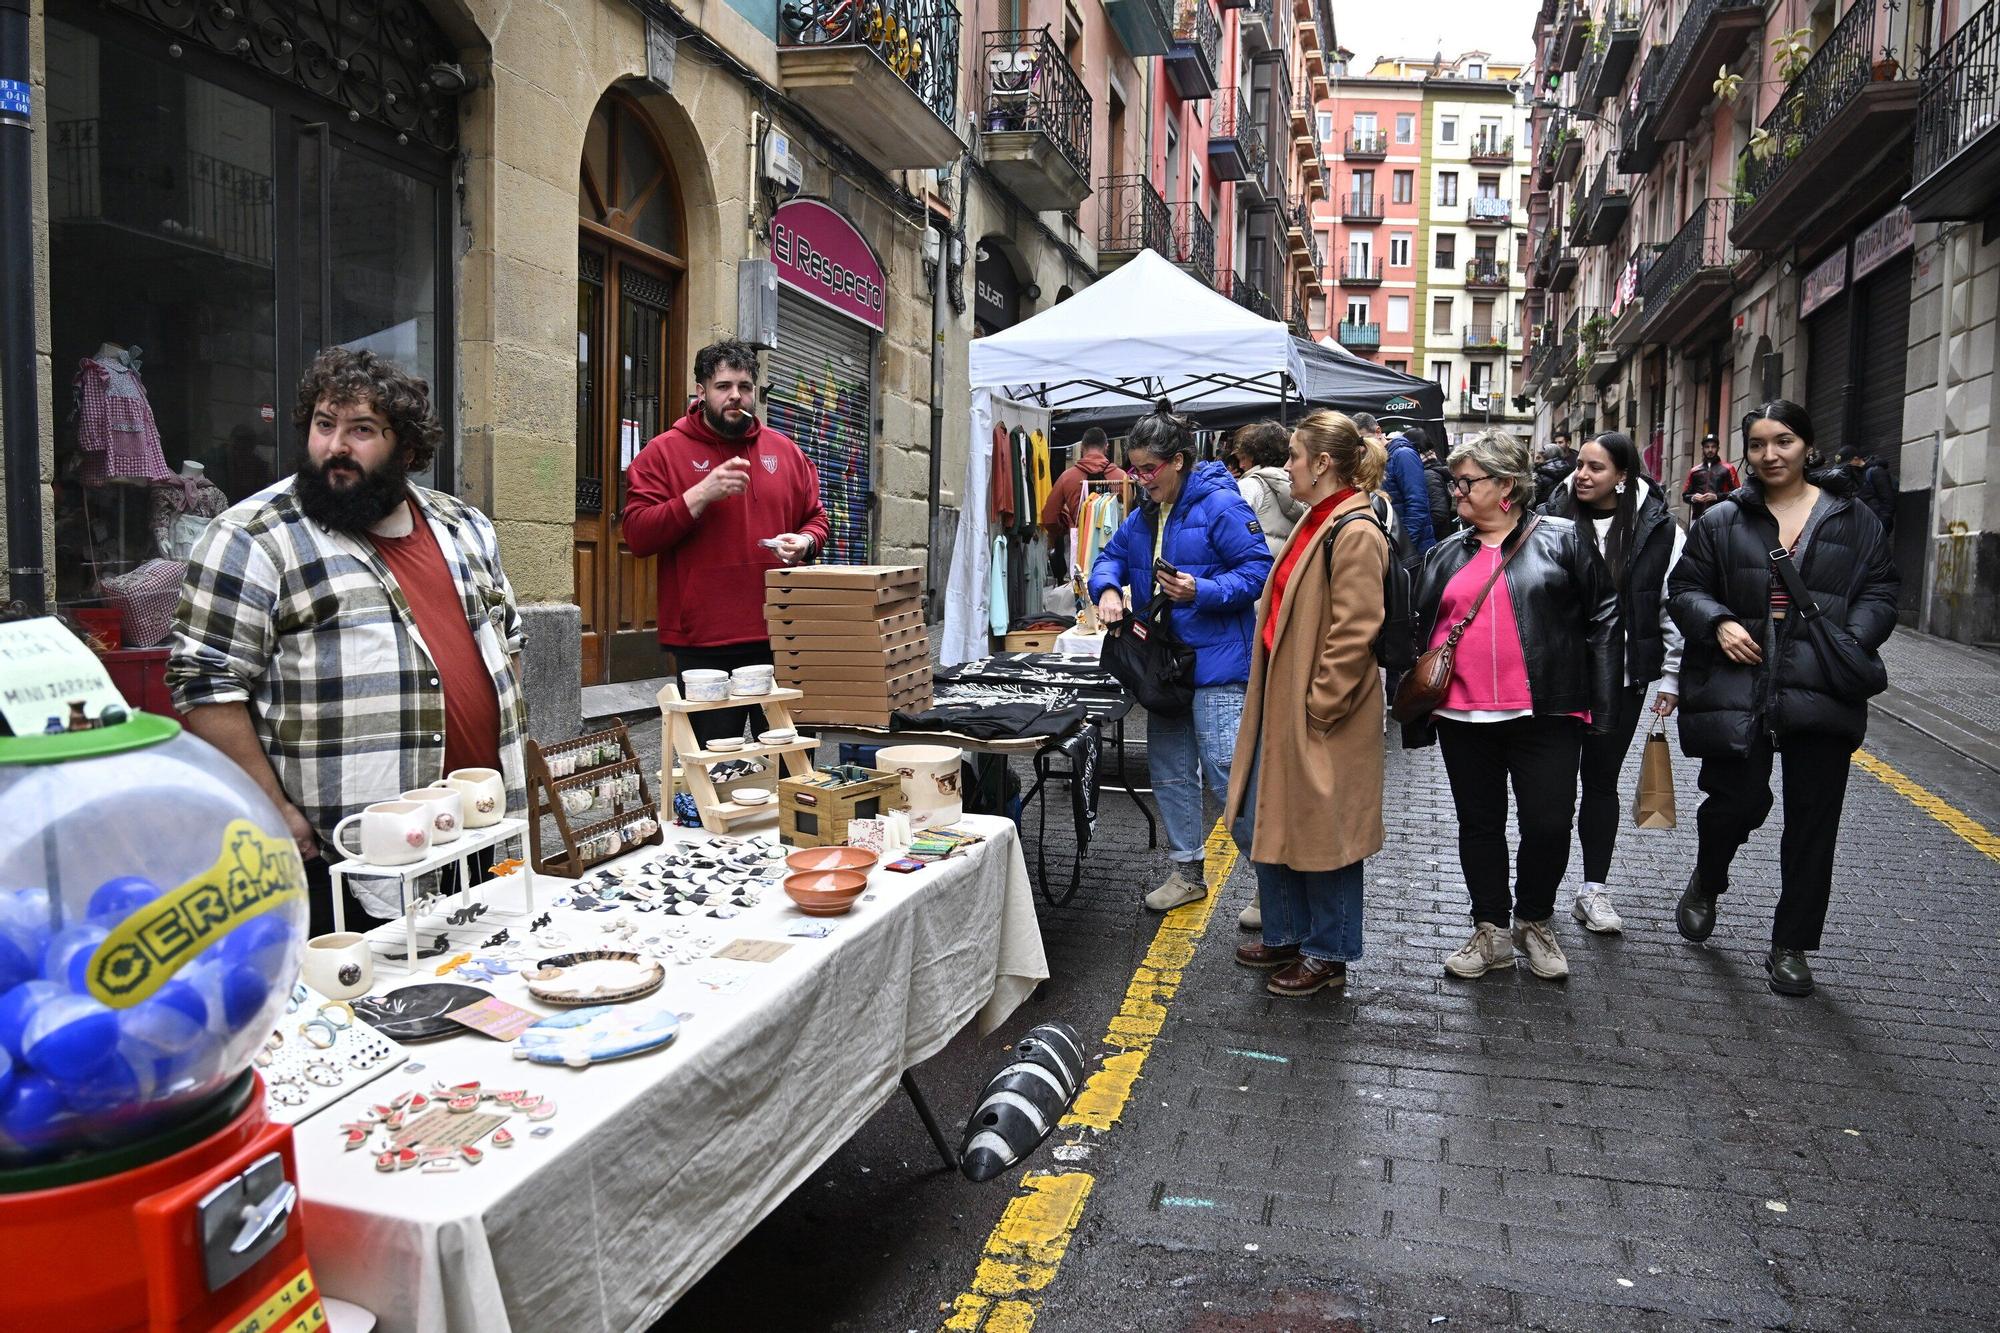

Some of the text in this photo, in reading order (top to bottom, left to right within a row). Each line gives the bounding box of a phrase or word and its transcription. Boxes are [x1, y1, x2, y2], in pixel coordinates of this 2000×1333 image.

[774, 223, 883, 313] El Respecto
[1385, 402, 1416, 411] COBIZI
